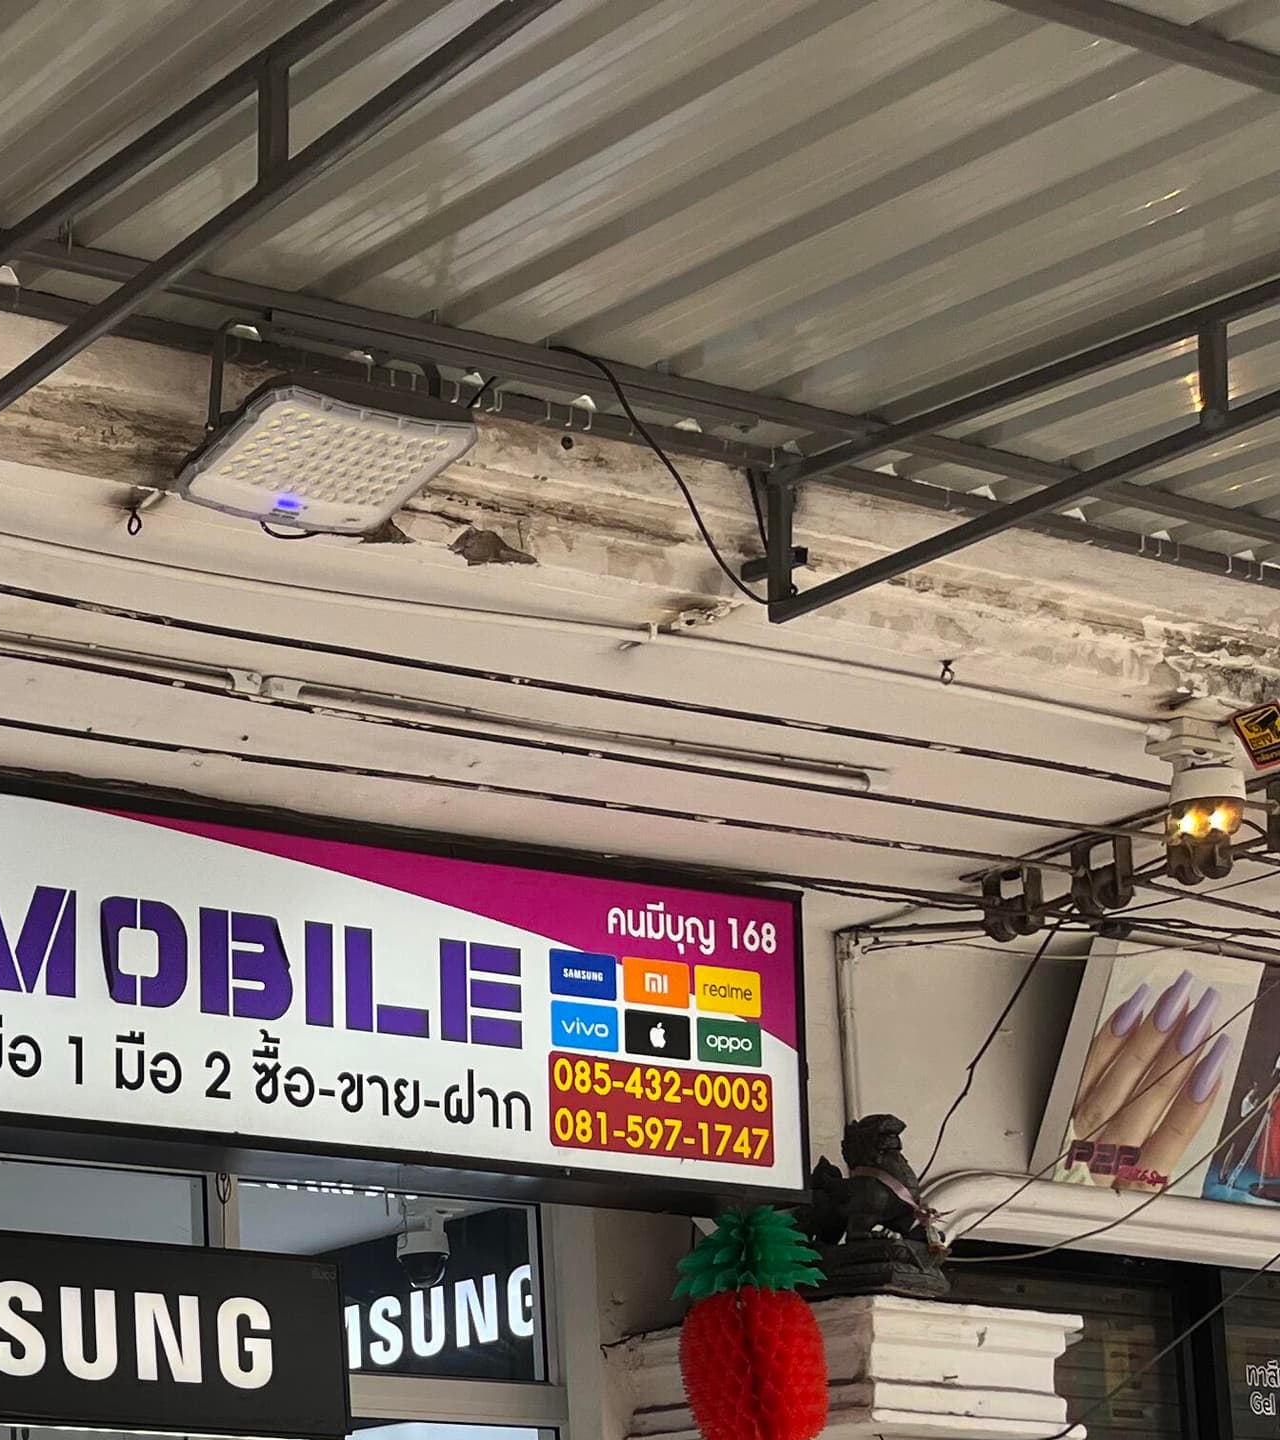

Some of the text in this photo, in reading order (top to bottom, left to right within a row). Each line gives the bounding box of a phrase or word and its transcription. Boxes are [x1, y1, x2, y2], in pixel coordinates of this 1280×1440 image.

[607, 901, 778, 955] คนมีบุญ 168
[562, 967, 753, 1002] SAMSUNG realme
[561, 1017, 753, 1053] vivo oppo
[68, 1036, 85, 1085] 1
[114, 1029, 183, 1094] มือ
[206, 1052, 231, 1100] 2
[553, 1057, 769, 1113] 085-432-0003
[554, 1107, 770, 1160] 081-597-1747
[1249, 1391, 1277, 1417] Gel
